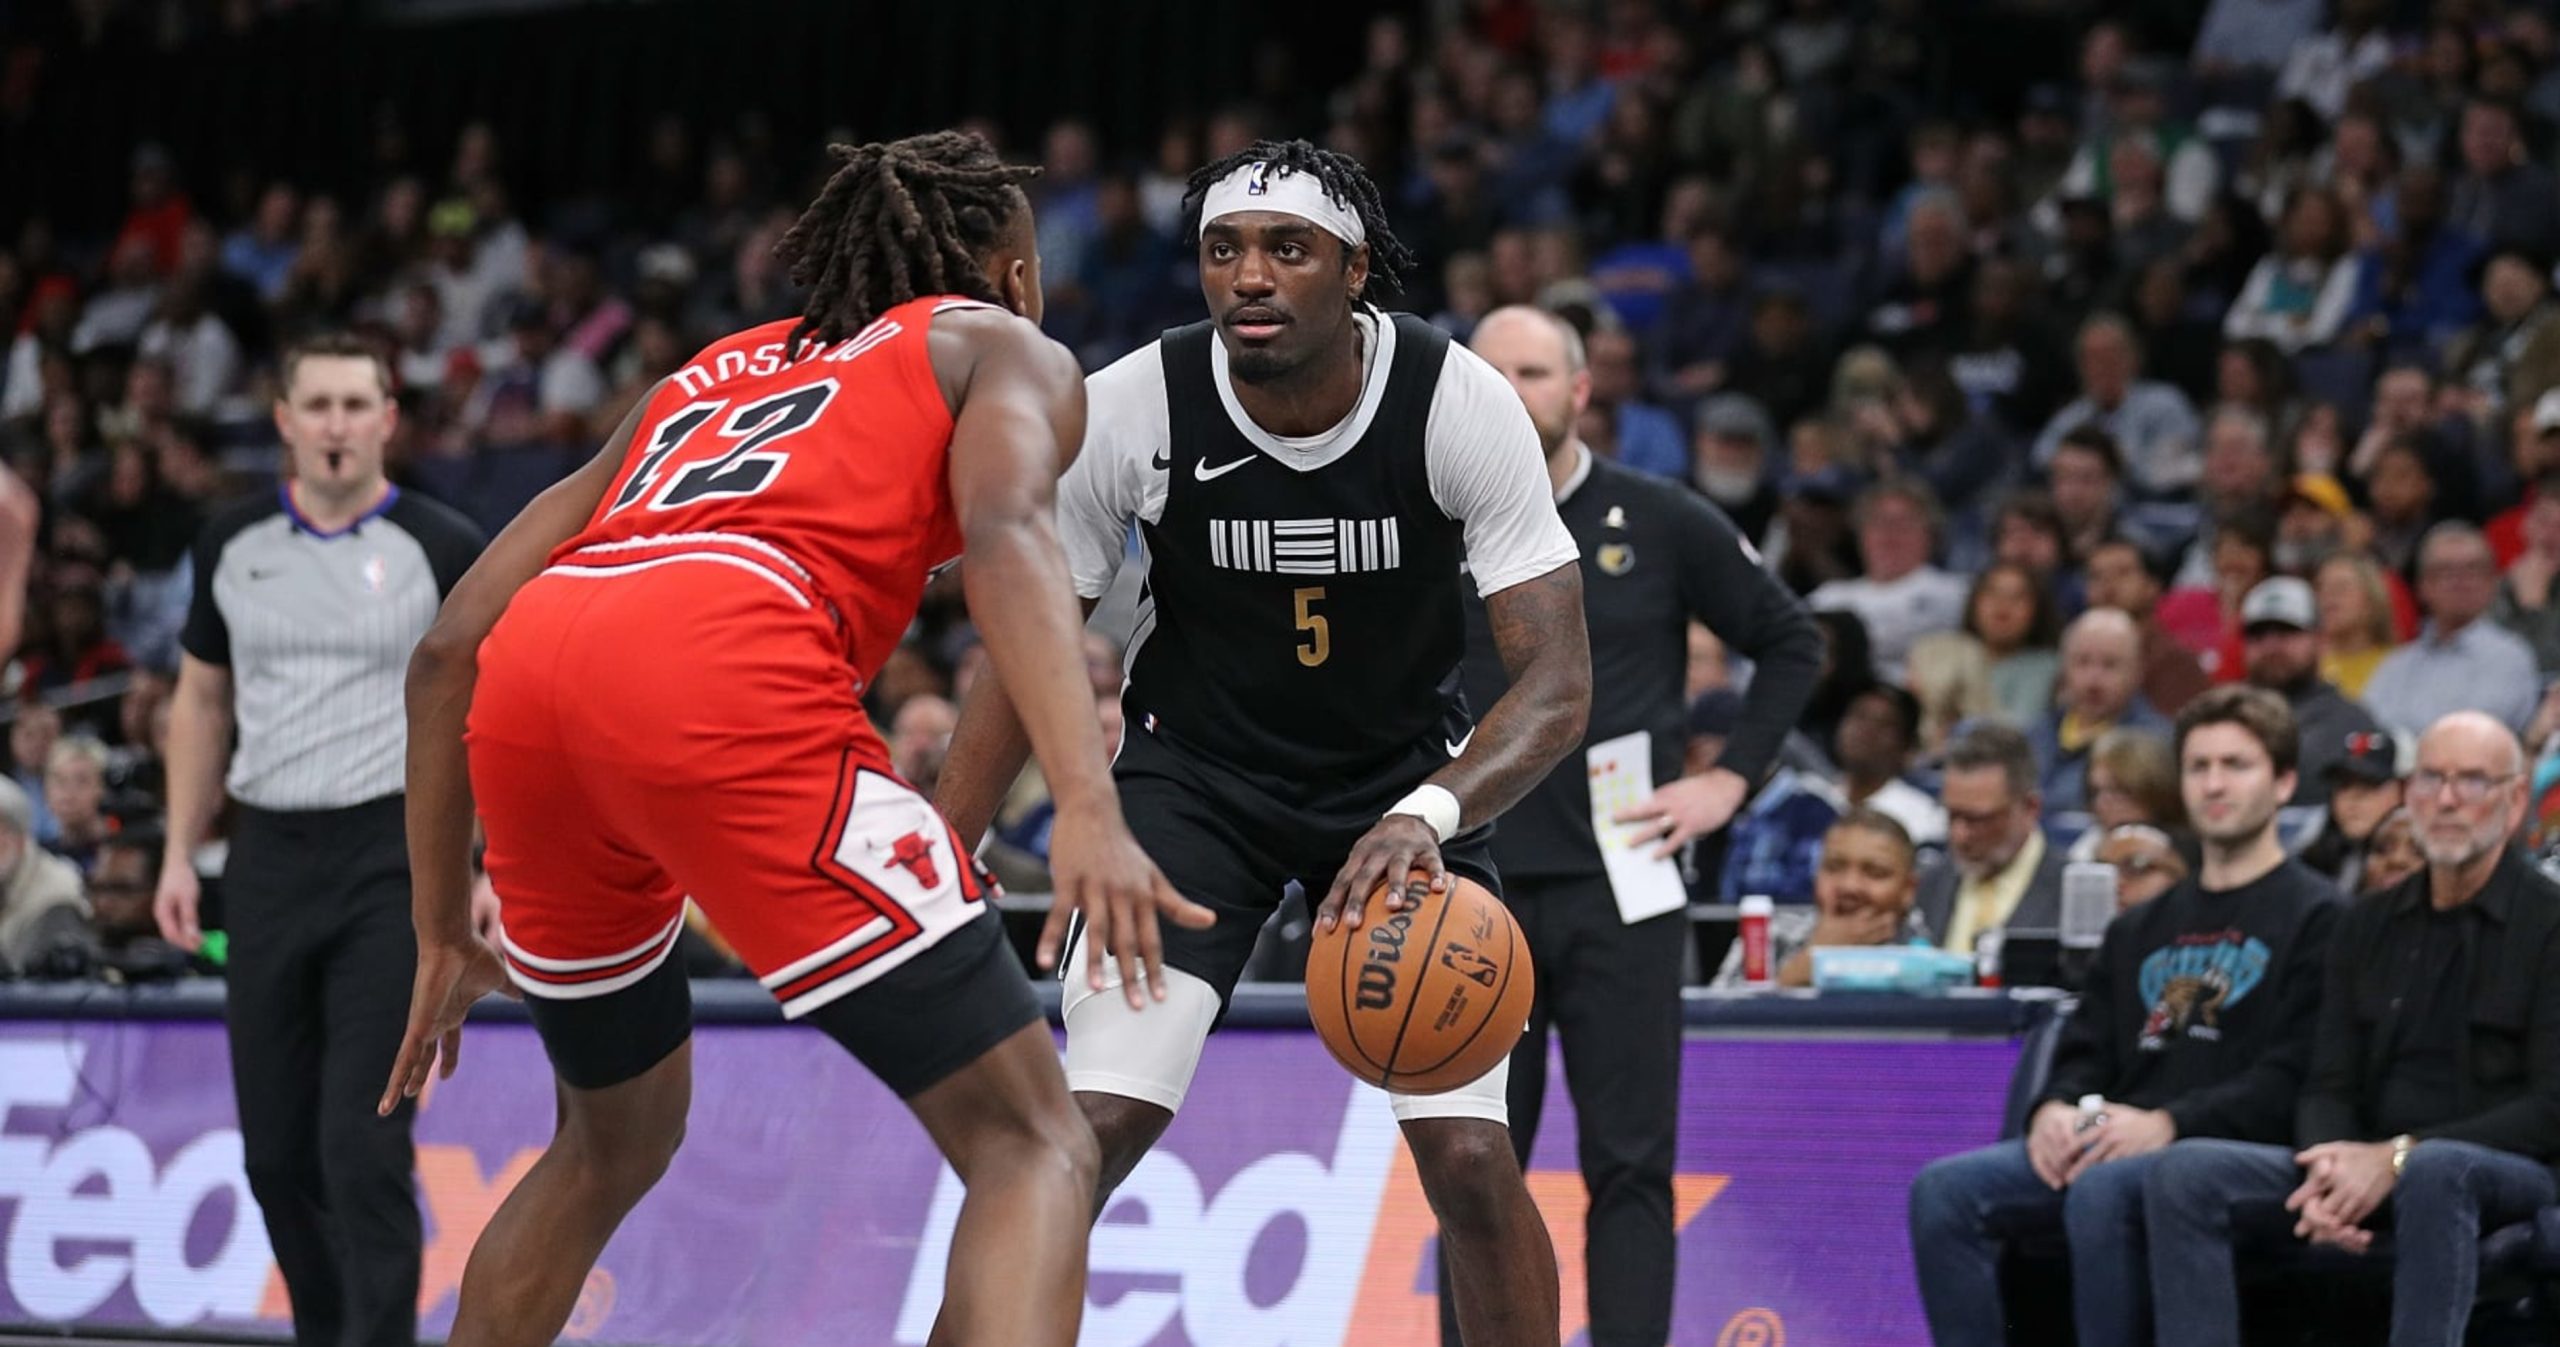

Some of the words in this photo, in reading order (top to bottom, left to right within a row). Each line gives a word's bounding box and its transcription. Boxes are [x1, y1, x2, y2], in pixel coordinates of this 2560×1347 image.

[601, 377, 841, 523] 12
[1294, 587, 1330, 666] 5
[1355, 881, 1430, 1011] Wilson
